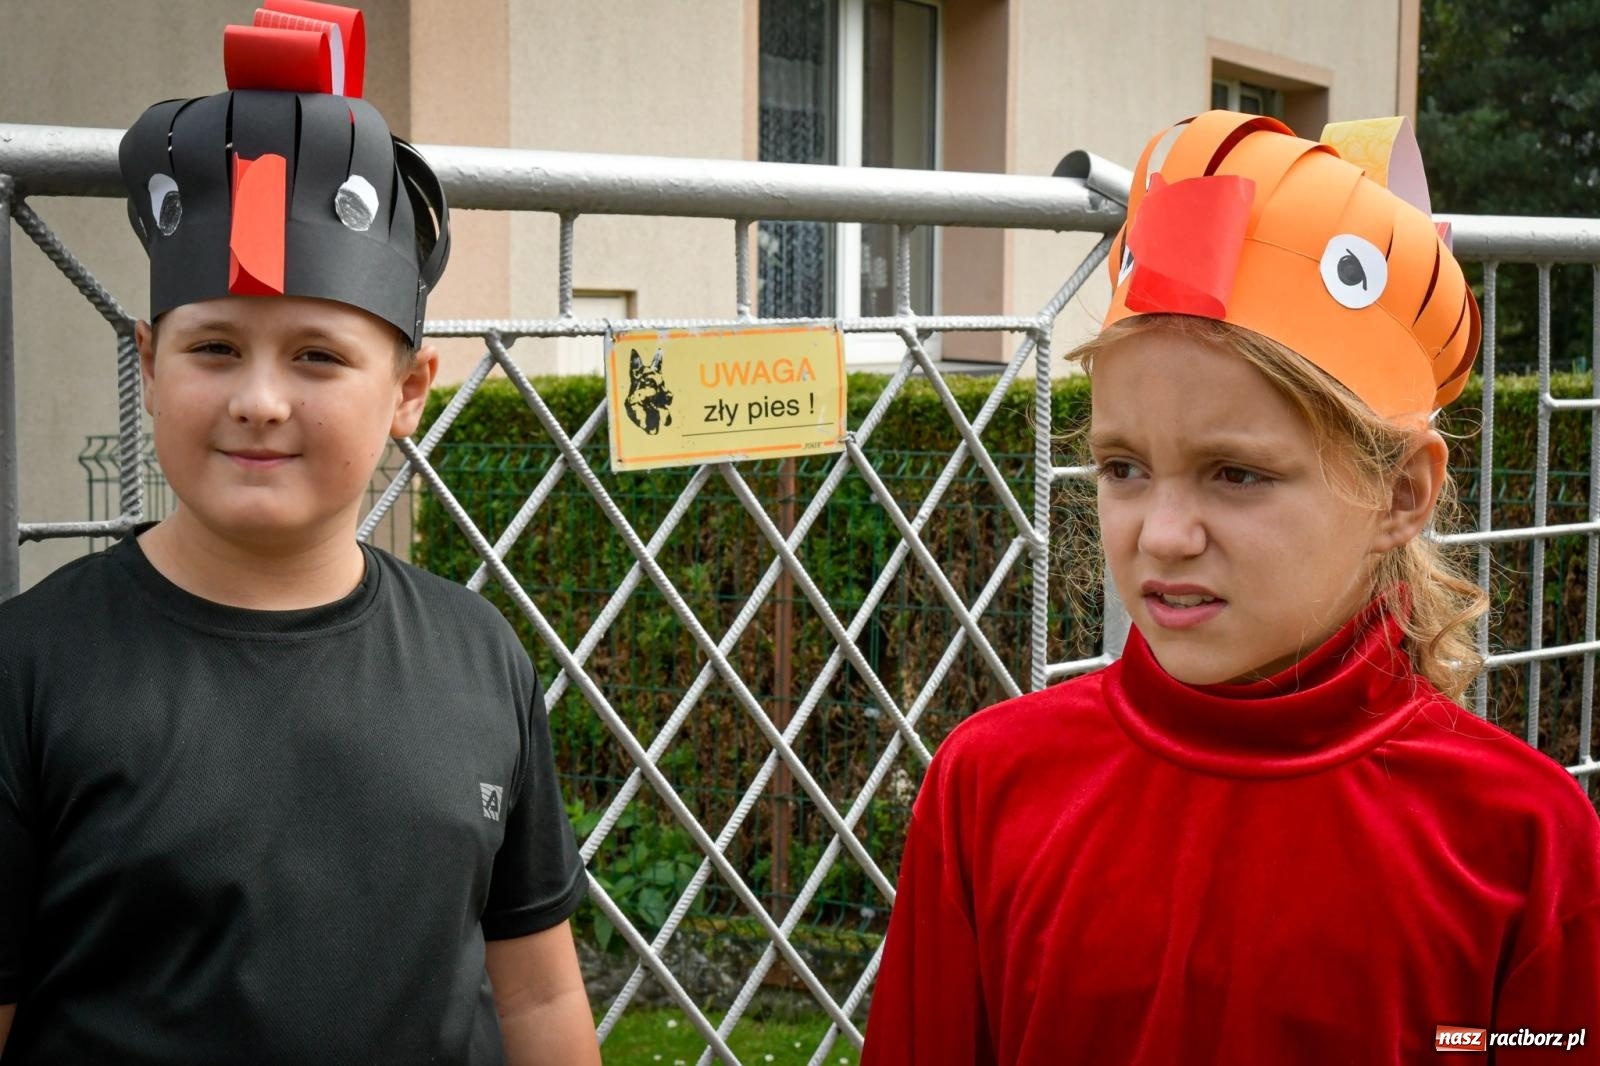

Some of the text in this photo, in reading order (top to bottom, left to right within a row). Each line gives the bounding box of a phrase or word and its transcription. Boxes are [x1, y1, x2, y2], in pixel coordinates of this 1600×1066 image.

[699, 357, 817, 389] UWAGA
[704, 398, 739, 427] zły
[748, 395, 800, 425] pies
